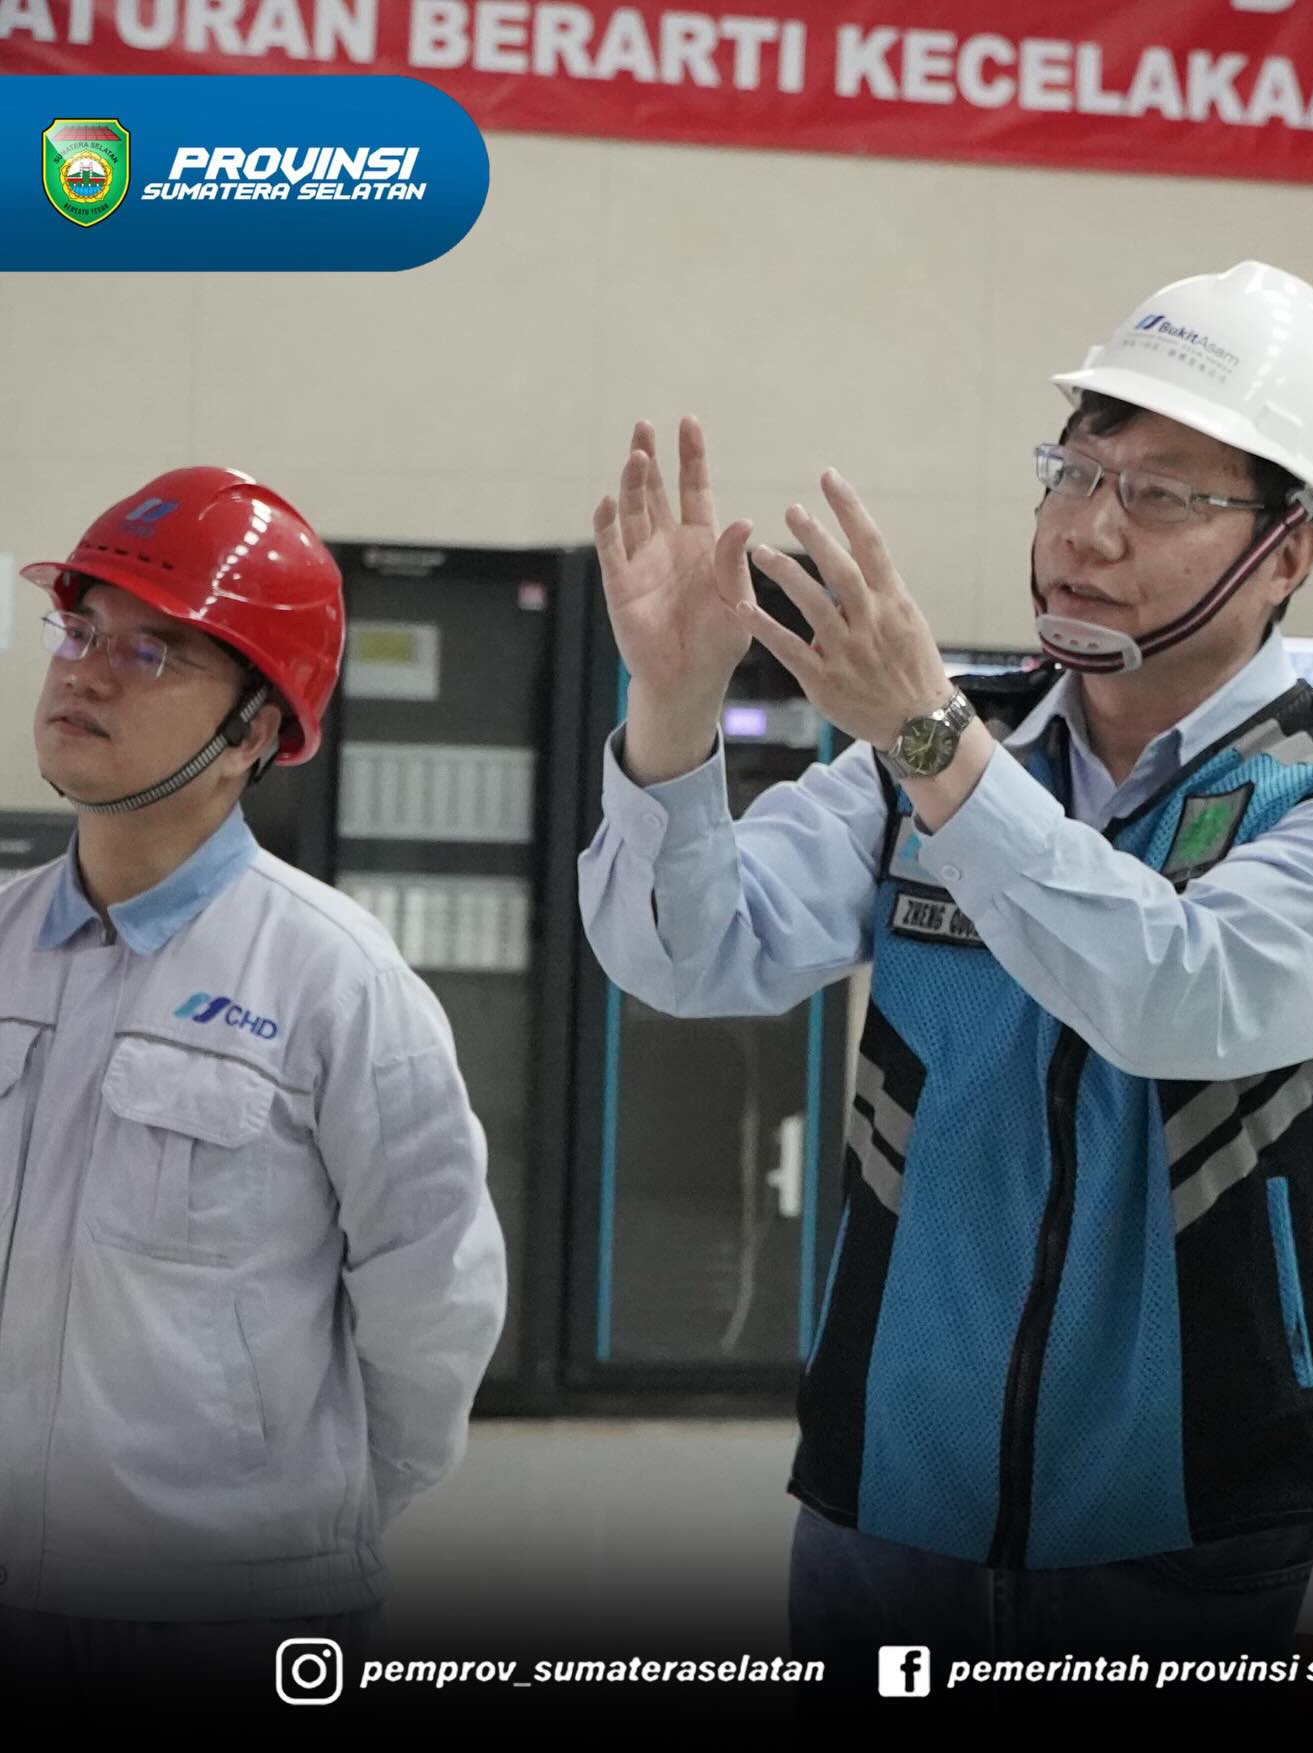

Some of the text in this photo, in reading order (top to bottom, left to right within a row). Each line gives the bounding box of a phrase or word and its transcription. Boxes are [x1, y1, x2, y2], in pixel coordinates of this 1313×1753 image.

[408, 0, 804, 97] BERARTI
[902, 900, 946, 931] ZHENG
[225, 1004, 278, 1039] CHD
